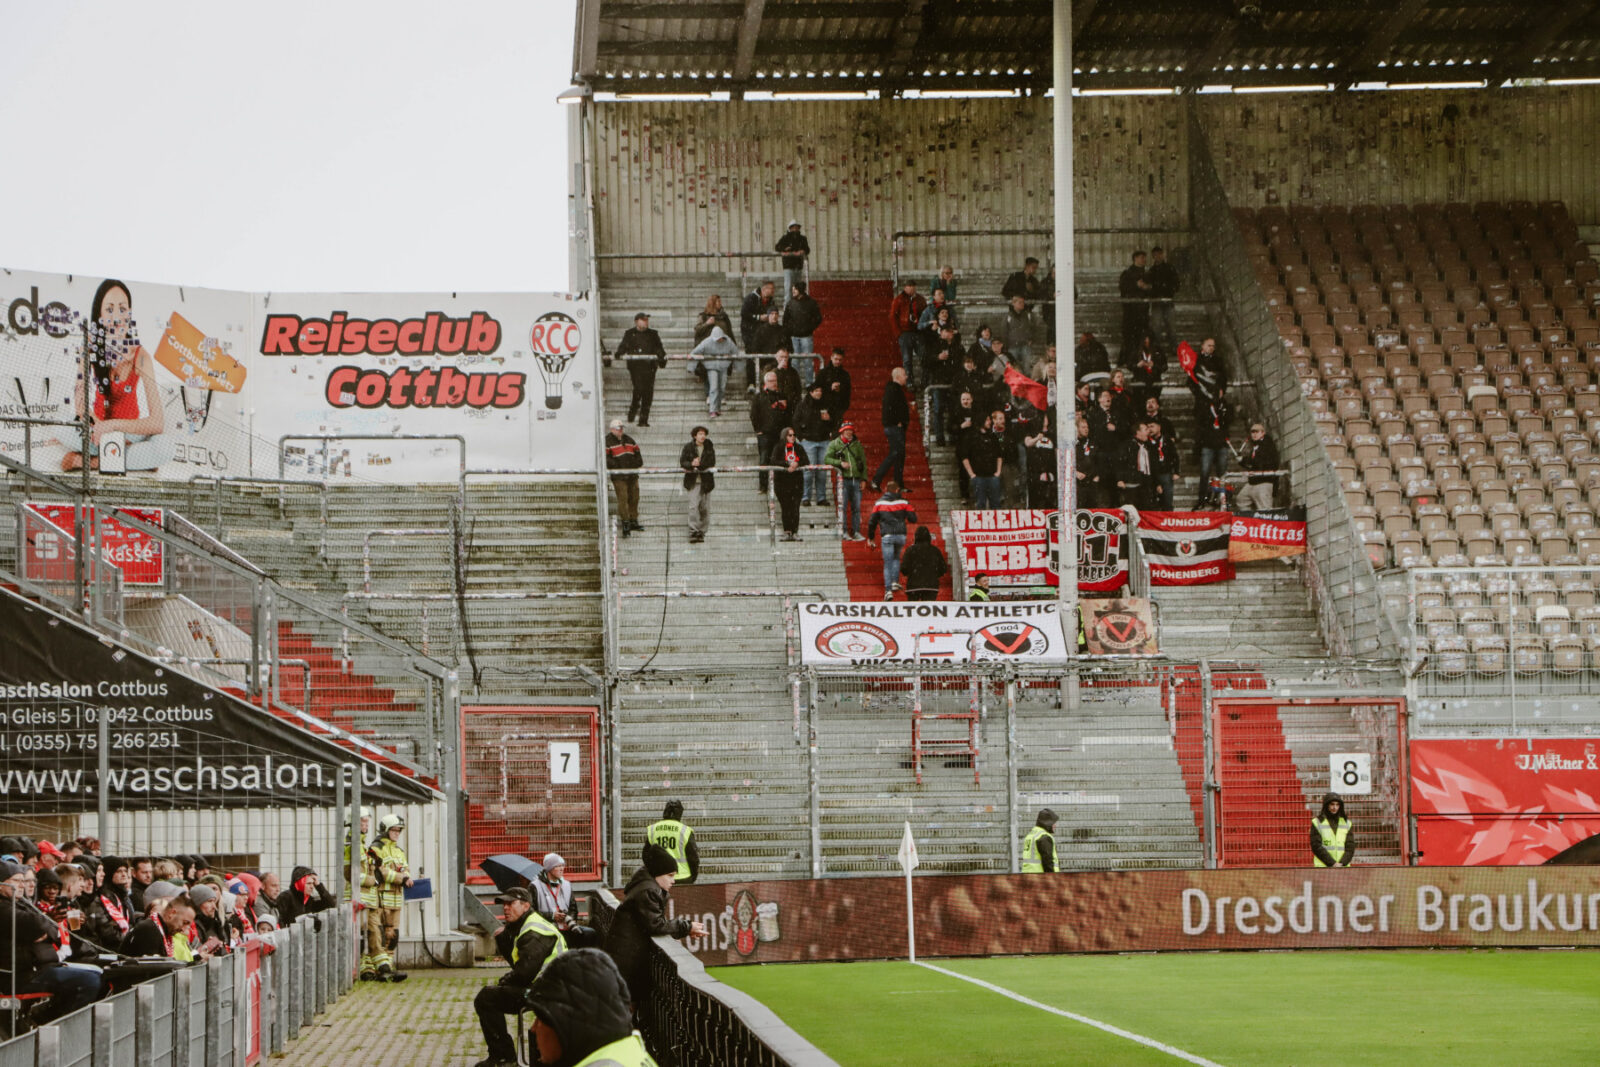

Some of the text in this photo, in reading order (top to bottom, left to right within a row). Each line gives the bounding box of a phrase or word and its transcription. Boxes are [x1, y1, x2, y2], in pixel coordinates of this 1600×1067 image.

[261, 311, 501, 356] Reiseclub
[532, 322, 578, 354] RCC
[325, 365, 526, 409] Cottbus
[951, 509, 1046, 530] VEREINS
[1160, 517, 1211, 527] JUNIORS
[961, 544, 1046, 570] LIEBE
[805, 603, 1056, 618] CARSHALTON ATHLETIC
[995, 624, 1019, 632] 1904
[97, 680, 168, 697] Cottbus
[12, 707, 57, 724] Gleis
[60, 708, 71, 724] 5
[143, 704, 213, 721] Cottbus
[16, 732, 71, 754] (0355)
[112, 733, 145, 748] 266
[148, 732, 180, 748] 251
[560, 753, 571, 773] 7
[1343, 761, 1358, 786] 8
[656, 836, 677, 850] 180
[1181, 881, 1394, 935] Dresdner
